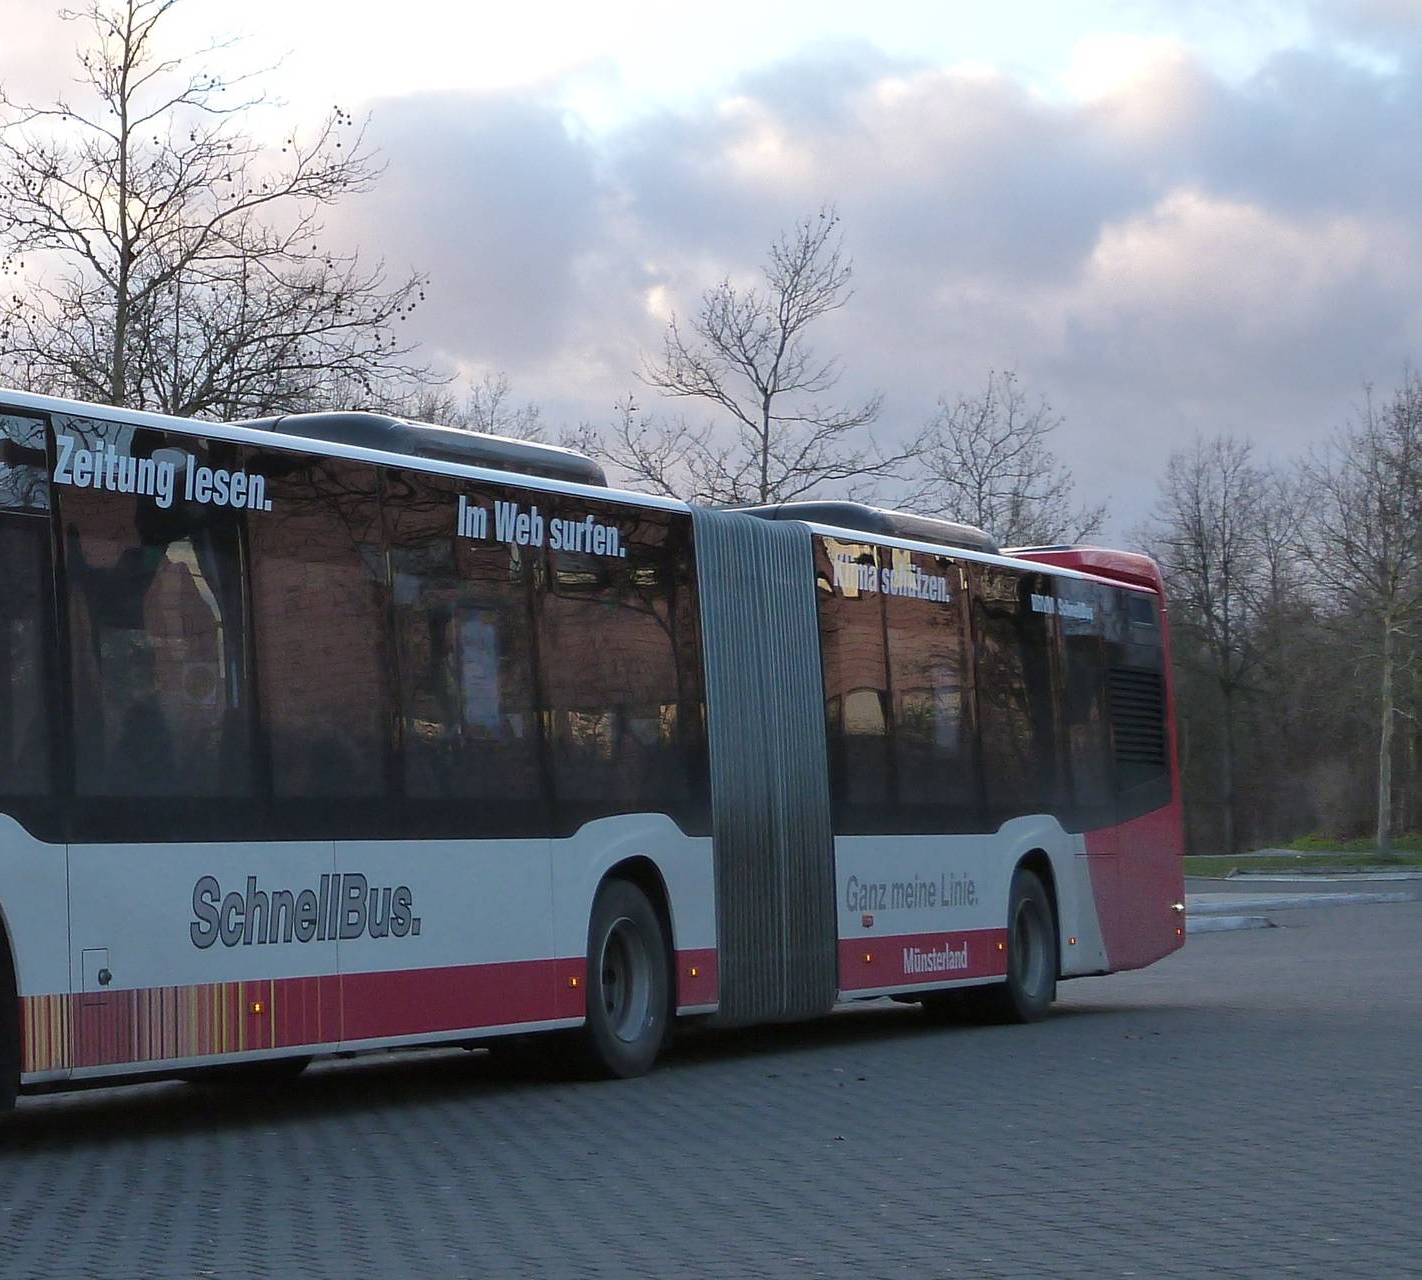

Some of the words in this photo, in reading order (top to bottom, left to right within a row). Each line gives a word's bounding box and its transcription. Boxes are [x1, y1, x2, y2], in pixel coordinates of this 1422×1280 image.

[53, 434, 178, 509] Zeitung
[184, 454, 272, 512] lesen.
[457, 494, 487, 540] Im
[493, 500, 544, 547] Web
[549, 514, 626, 558] surfen.
[190, 873, 421, 949] SchnellBus.
[846, 875, 887, 912] Ganz
[890, 875, 936, 909] meine
[941, 873, 979, 906] Linie.
[903, 941, 968, 974] Münsterland
